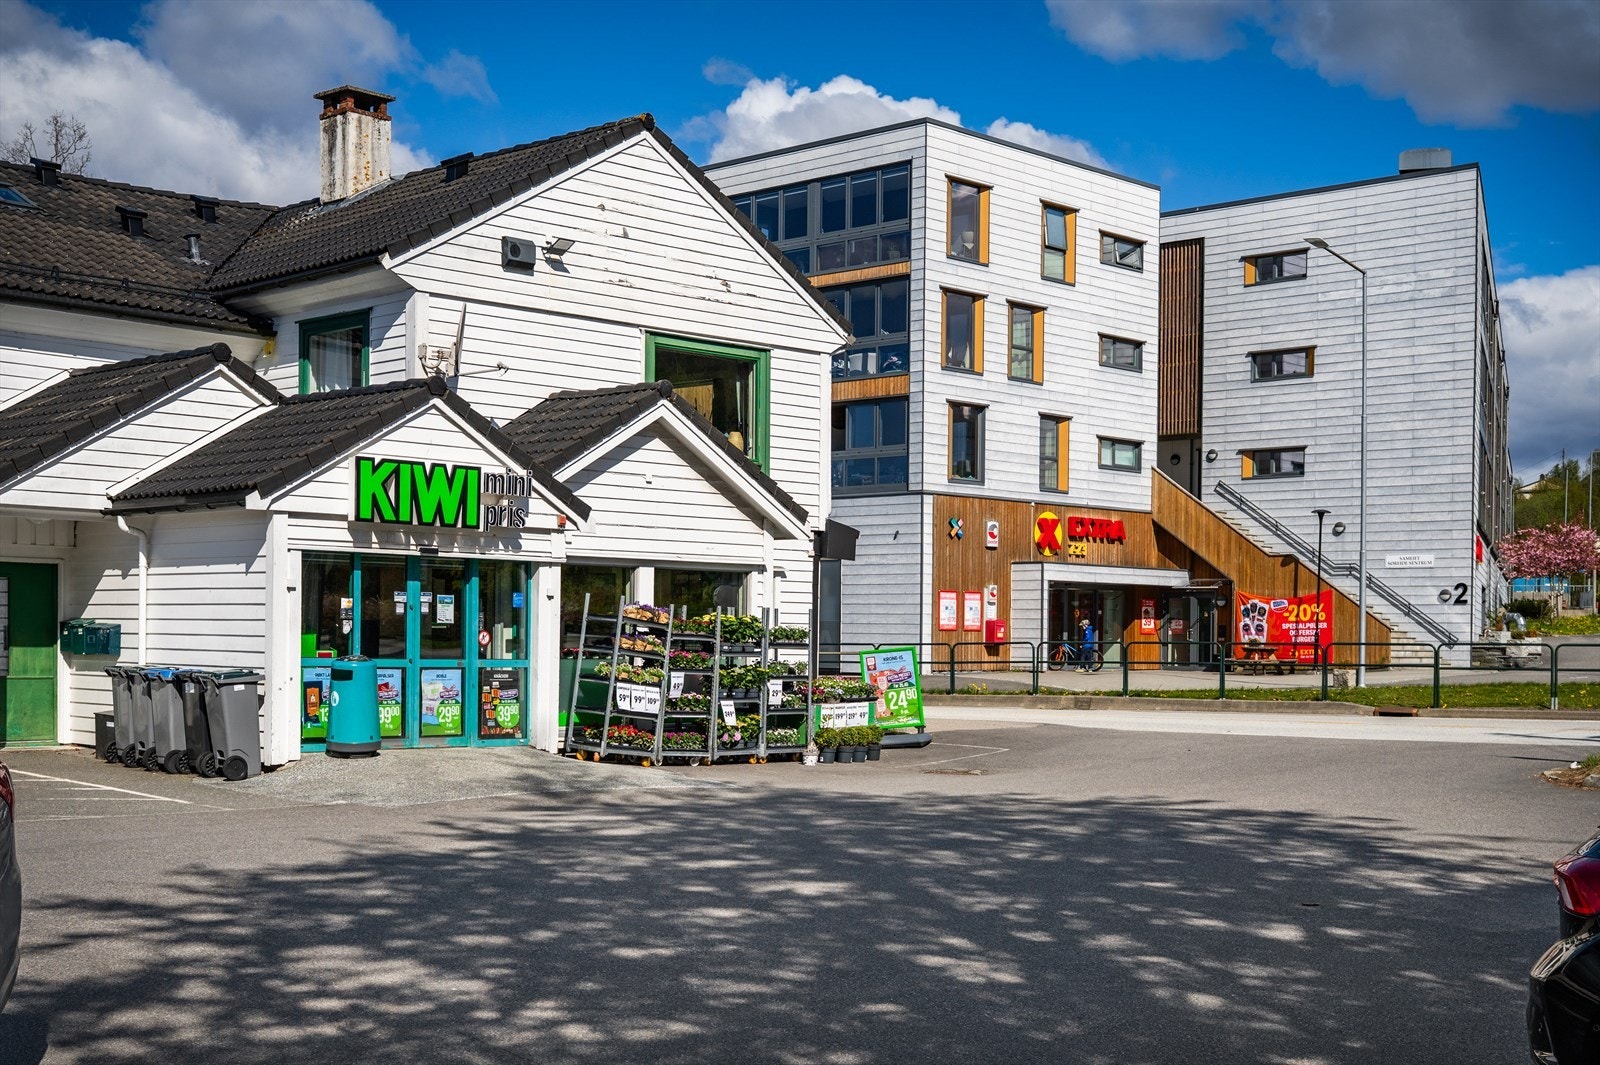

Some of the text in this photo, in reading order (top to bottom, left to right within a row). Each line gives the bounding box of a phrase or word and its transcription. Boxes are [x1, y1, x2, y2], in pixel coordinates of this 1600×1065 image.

[356, 457, 481, 529] KIWI
[484, 467, 533, 497] mini
[484, 500, 526, 532] pris
[1068, 516, 1126, 540] EXTRA
[1453, 583, 1468, 605] 2
[1283, 603, 1326, 621] -20%
